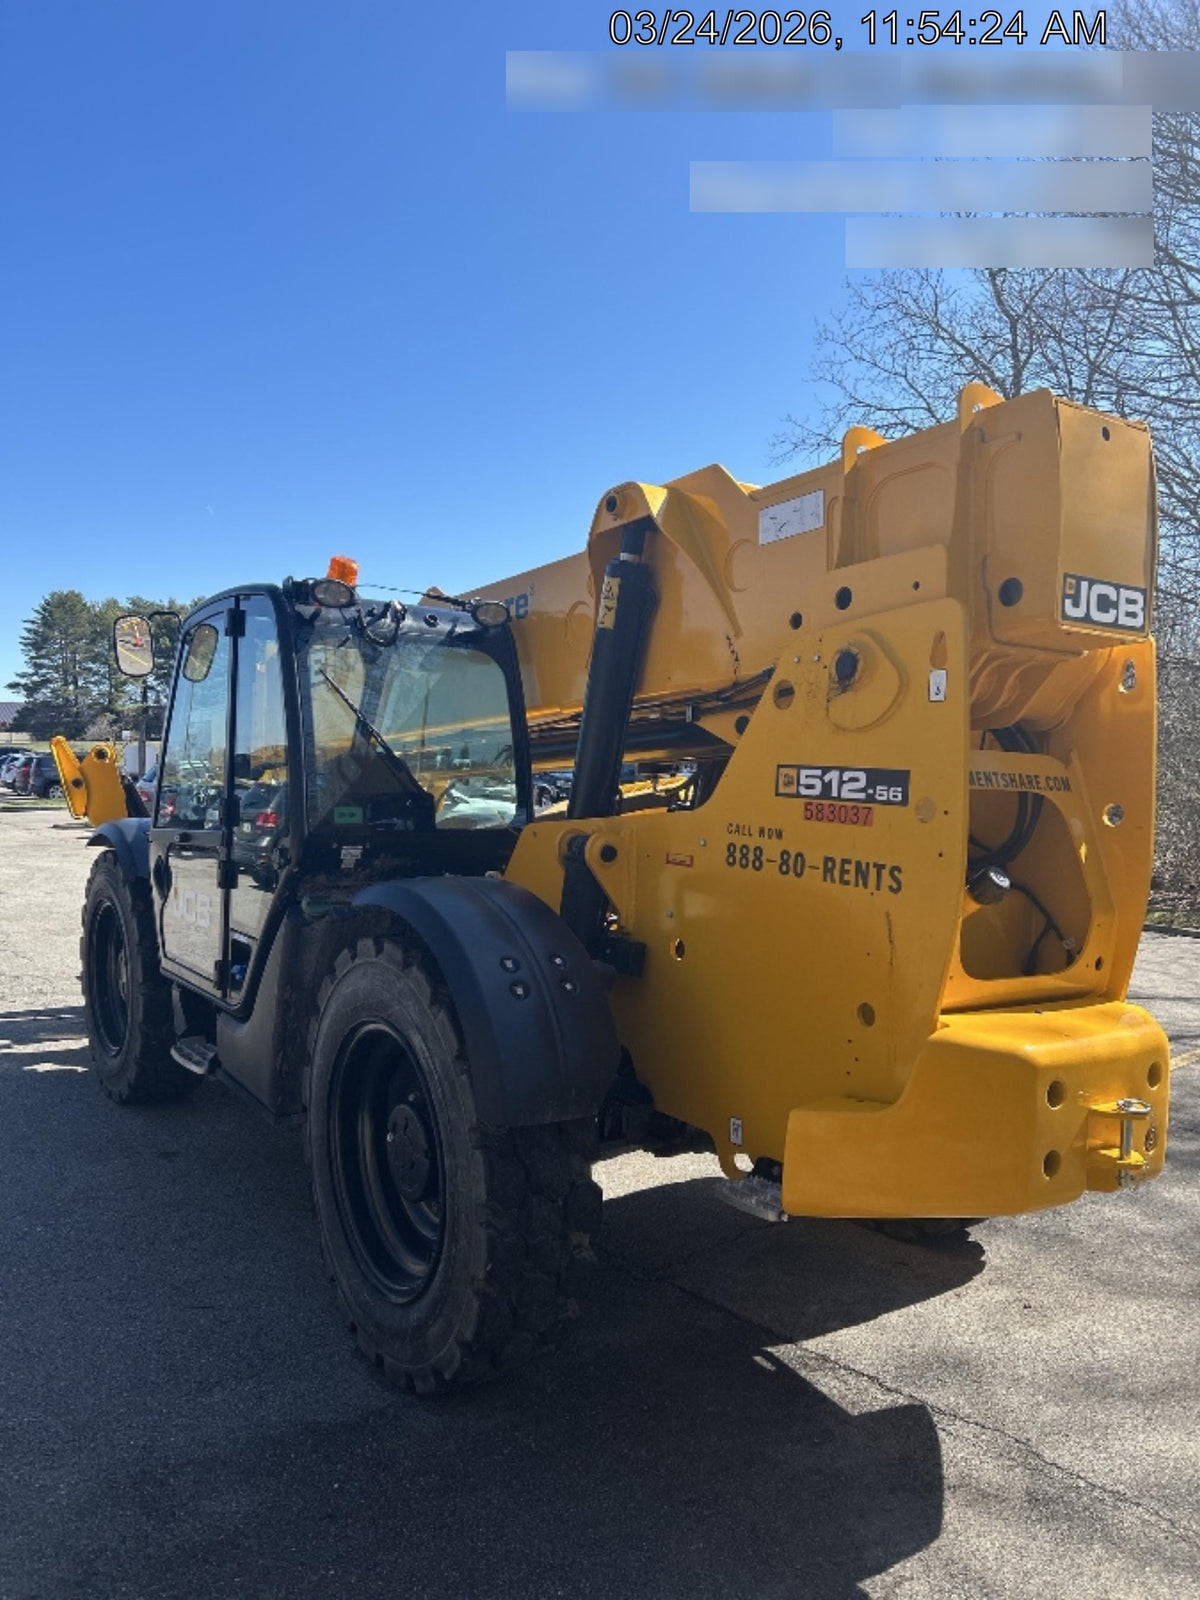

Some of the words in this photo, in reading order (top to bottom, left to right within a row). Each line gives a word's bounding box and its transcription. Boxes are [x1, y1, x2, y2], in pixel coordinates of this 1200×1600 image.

[1064, 580, 1145, 628] JCB
[798, 768, 903, 802] 512-56
[803, 801, 873, 826] 583037
[726, 822, 753, 837] CALL
[758, 826, 784, 840] NOW
[725, 841, 904, 895] 888-80-RENTS
